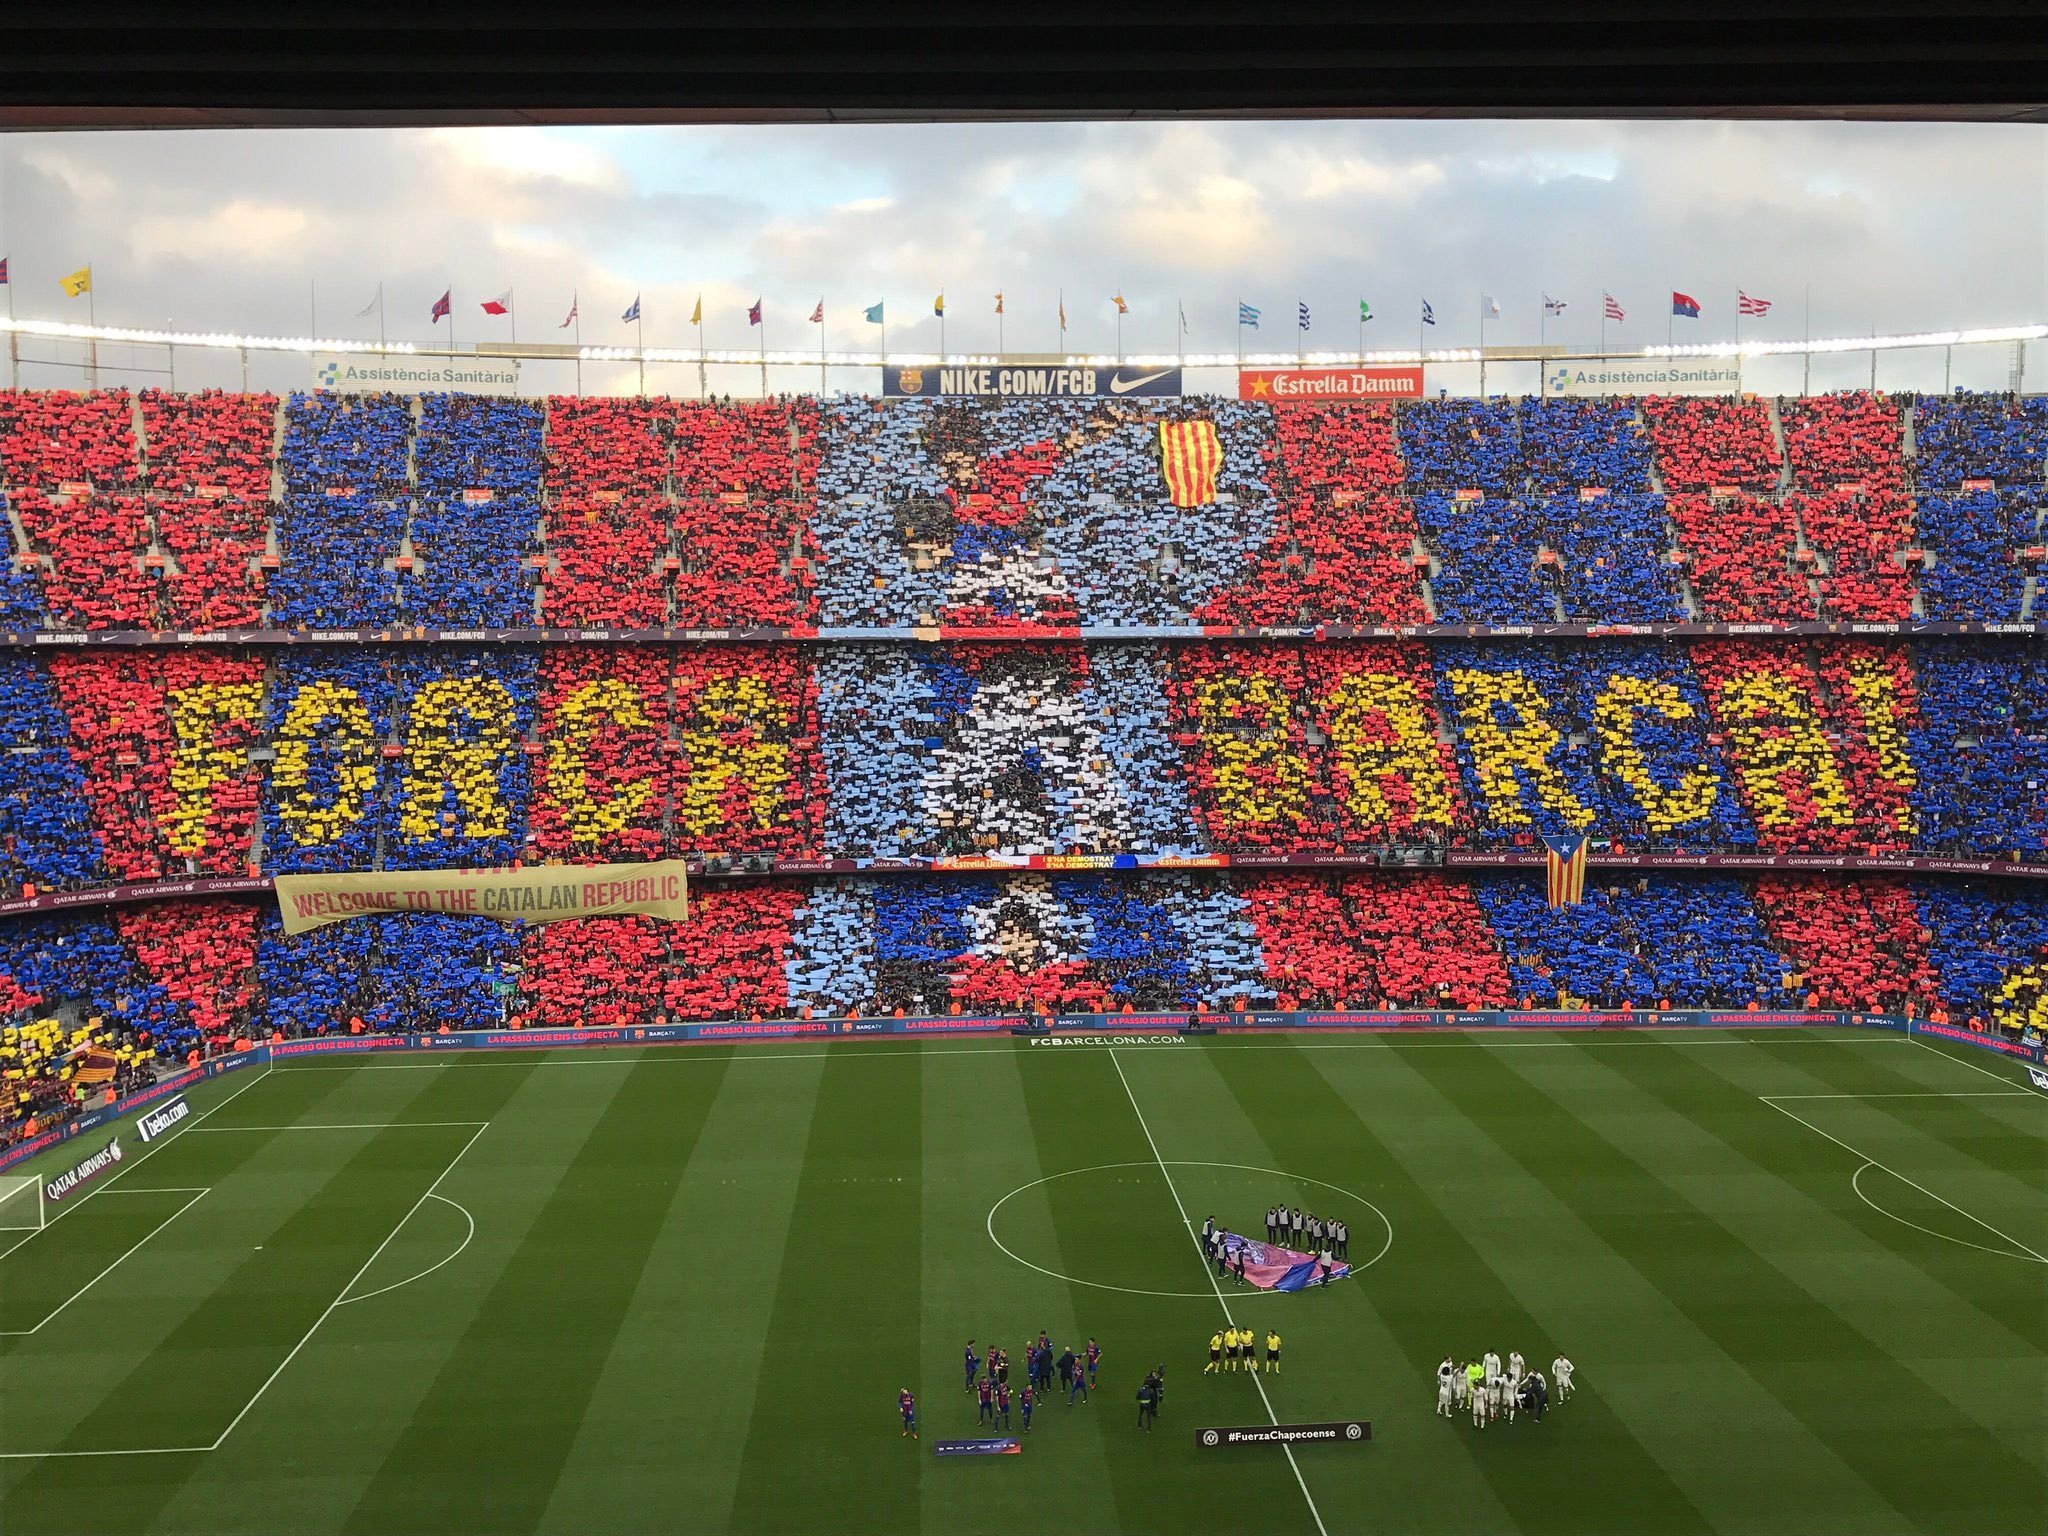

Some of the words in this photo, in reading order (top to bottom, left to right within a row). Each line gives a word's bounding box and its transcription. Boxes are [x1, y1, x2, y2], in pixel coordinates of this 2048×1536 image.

[346, 366, 440, 382] Assistència
[443, 368, 514, 383] Sanitària
[1575, 371, 1666, 385] Assistència
[1669, 368, 1739, 382] Sanitària
[940, 369, 1096, 395] NIKE.COM/FCB
[1272, 374, 1348, 395] Estrella
[1350, 374, 1414, 394] Damm
[1729, 625, 1772, 634] NIKE.COM/FCB
[1852, 624, 1899, 633] NIKE.COM/FCB
[36, 633, 88, 643] NIKE.COM/FCB
[312, 632, 358, 640] NIKE.COM/FCB
[440, 631, 486, 640] NIKE.COM/FCB
[686, 630, 729, 639] NIKE.COM/FCB
[1952, 862, 1980, 870] AIRWAYS
[132, 887, 153, 896] QATAR
[154, 884, 184, 894] AIRWAYS
[208, 882, 230, 890] QATAR
[232, 880, 260, 888] AIRWAYS
[54, 895, 76, 905] QATAR
[77, 892, 106, 902] AIRWAYS
[292, 890, 398, 919] WELCOME
[403, 890, 431, 909] TO
[437, 888, 477, 912] THE
[483, 884, 577, 912] CATALAN
[583, 875, 679, 908] REPUBLIC
[1387, 1014, 1431, 1022] CONNECTA
[1588, 1014, 1633, 1022] CONNECTA
[1790, 1014, 1836, 1022] CONNECTA
[744, 1026, 762, 1034] QUE
[782, 1024, 828, 1032] CONNECTA
[950, 1020, 967, 1028] QUE
[488, 1036, 499, 1044] LA
[533, 1034, 552, 1042] QUE
[572, 1031, 618, 1040] CONNECTA
[1030, 1036, 1185, 1046] FCBARCELONA.COM
[1920, 1024, 1930, 1032] LA
[1962, 1031, 1976, 1042] QUE
[1993, 1040, 2032, 1056] CONNECTA
[316, 1042, 336, 1052] QUE
[356, 1038, 405, 1048] CONNECTA
[118, 1104, 126, 1112] LA
[148, 1086, 162, 1098] QUE
[146, 1102, 189, 1137] beko.com
[47, 1171, 78, 1200] QATAR
[78, 1148, 112, 1181] AIRWAYS
[1228, 1429, 1336, 1442] #FuerzaChapecoense
